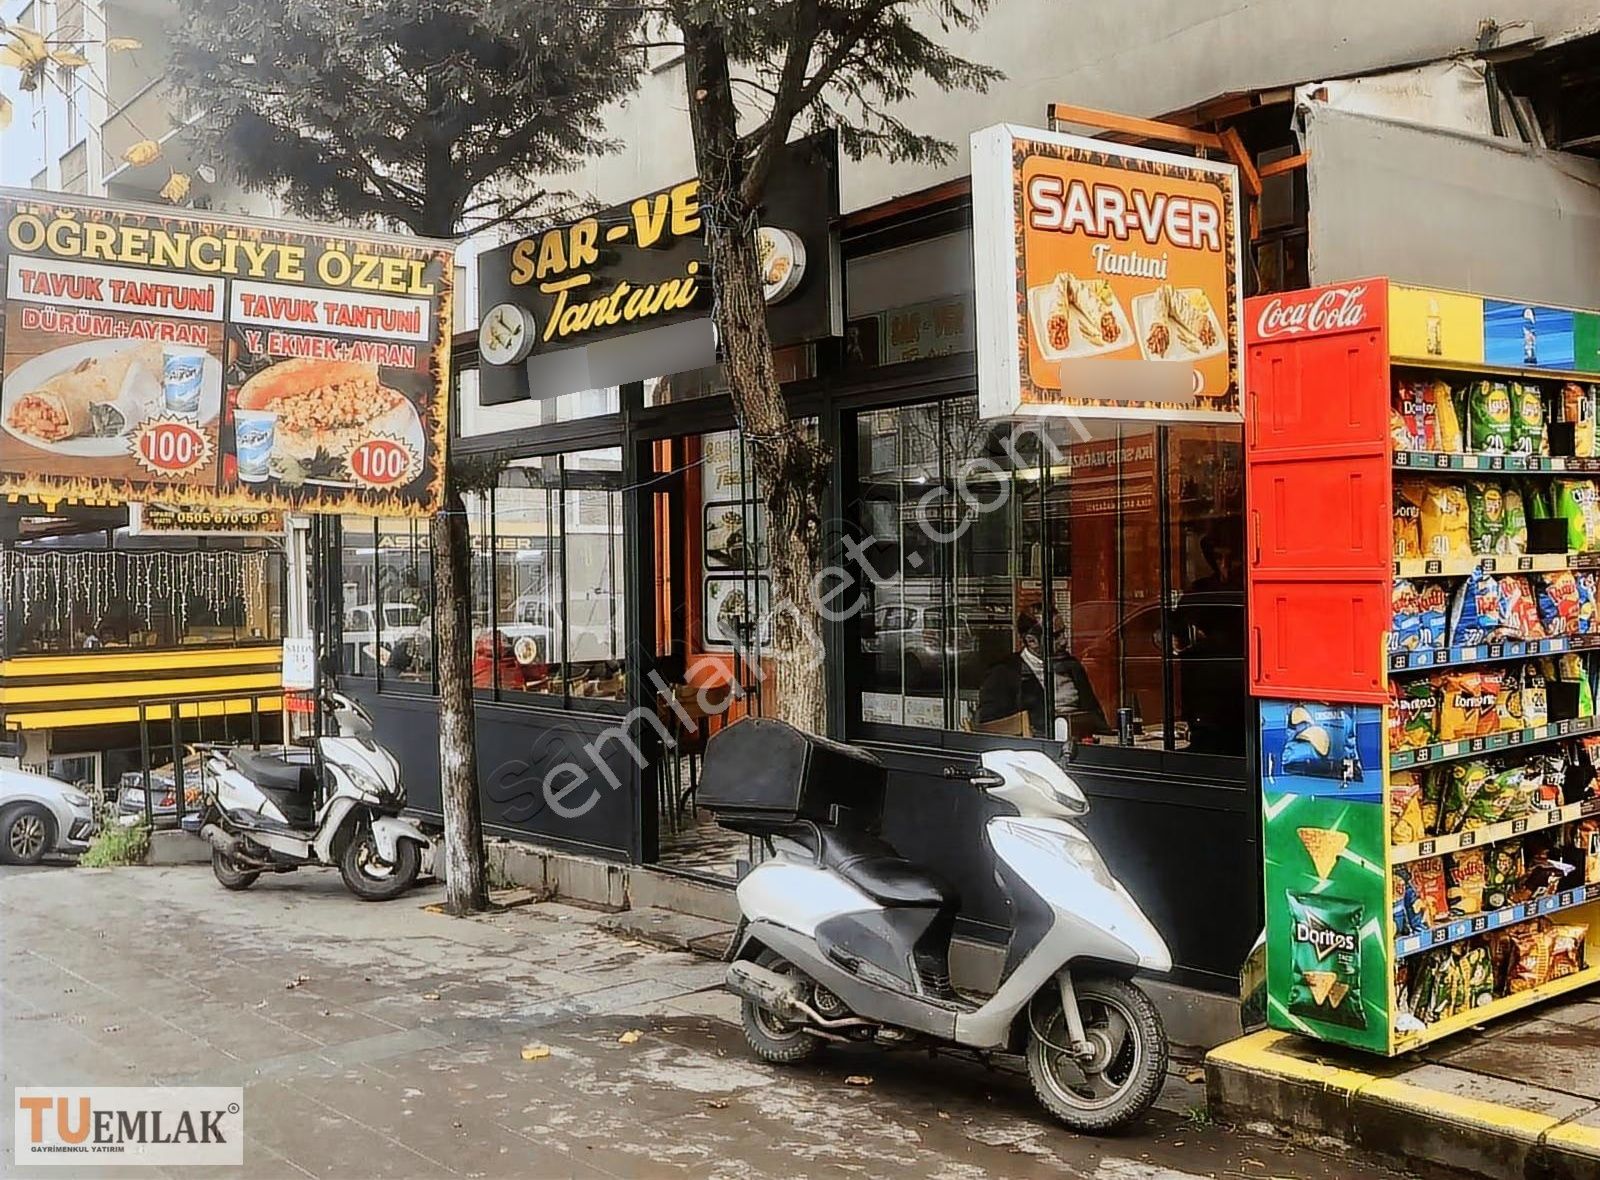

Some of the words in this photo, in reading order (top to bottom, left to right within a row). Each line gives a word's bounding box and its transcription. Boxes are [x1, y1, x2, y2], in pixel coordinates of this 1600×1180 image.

[510, 179, 701, 286] SAR-VE
[1028, 174, 1222, 252] SAR-VER
[8, 207, 305, 281] ÖĞRENCİYE
[317, 243, 435, 296] ÖZEL
[1092, 243, 1168, 280] Tantuni
[20, 269, 103, 301] TAVUK
[110, 279, 215, 313] TANTUNİ
[540, 261, 699, 343] Tantuni
[22, 306, 208, 346] DÜRÜM+AYRAN
[241, 293, 320, 322] TAVUK
[323, 303, 421, 333] TANTUNİ
[245, 330, 264, 353] Y.
[269, 333, 416, 369] EKMEK+AYRAN
[178, 512, 211, 524] 0505
[214, 513, 239, 524] 670
[242, 513, 258, 524] 50
[261, 513, 277, 524] 91
[1296, 922, 1355, 951] Doritos
